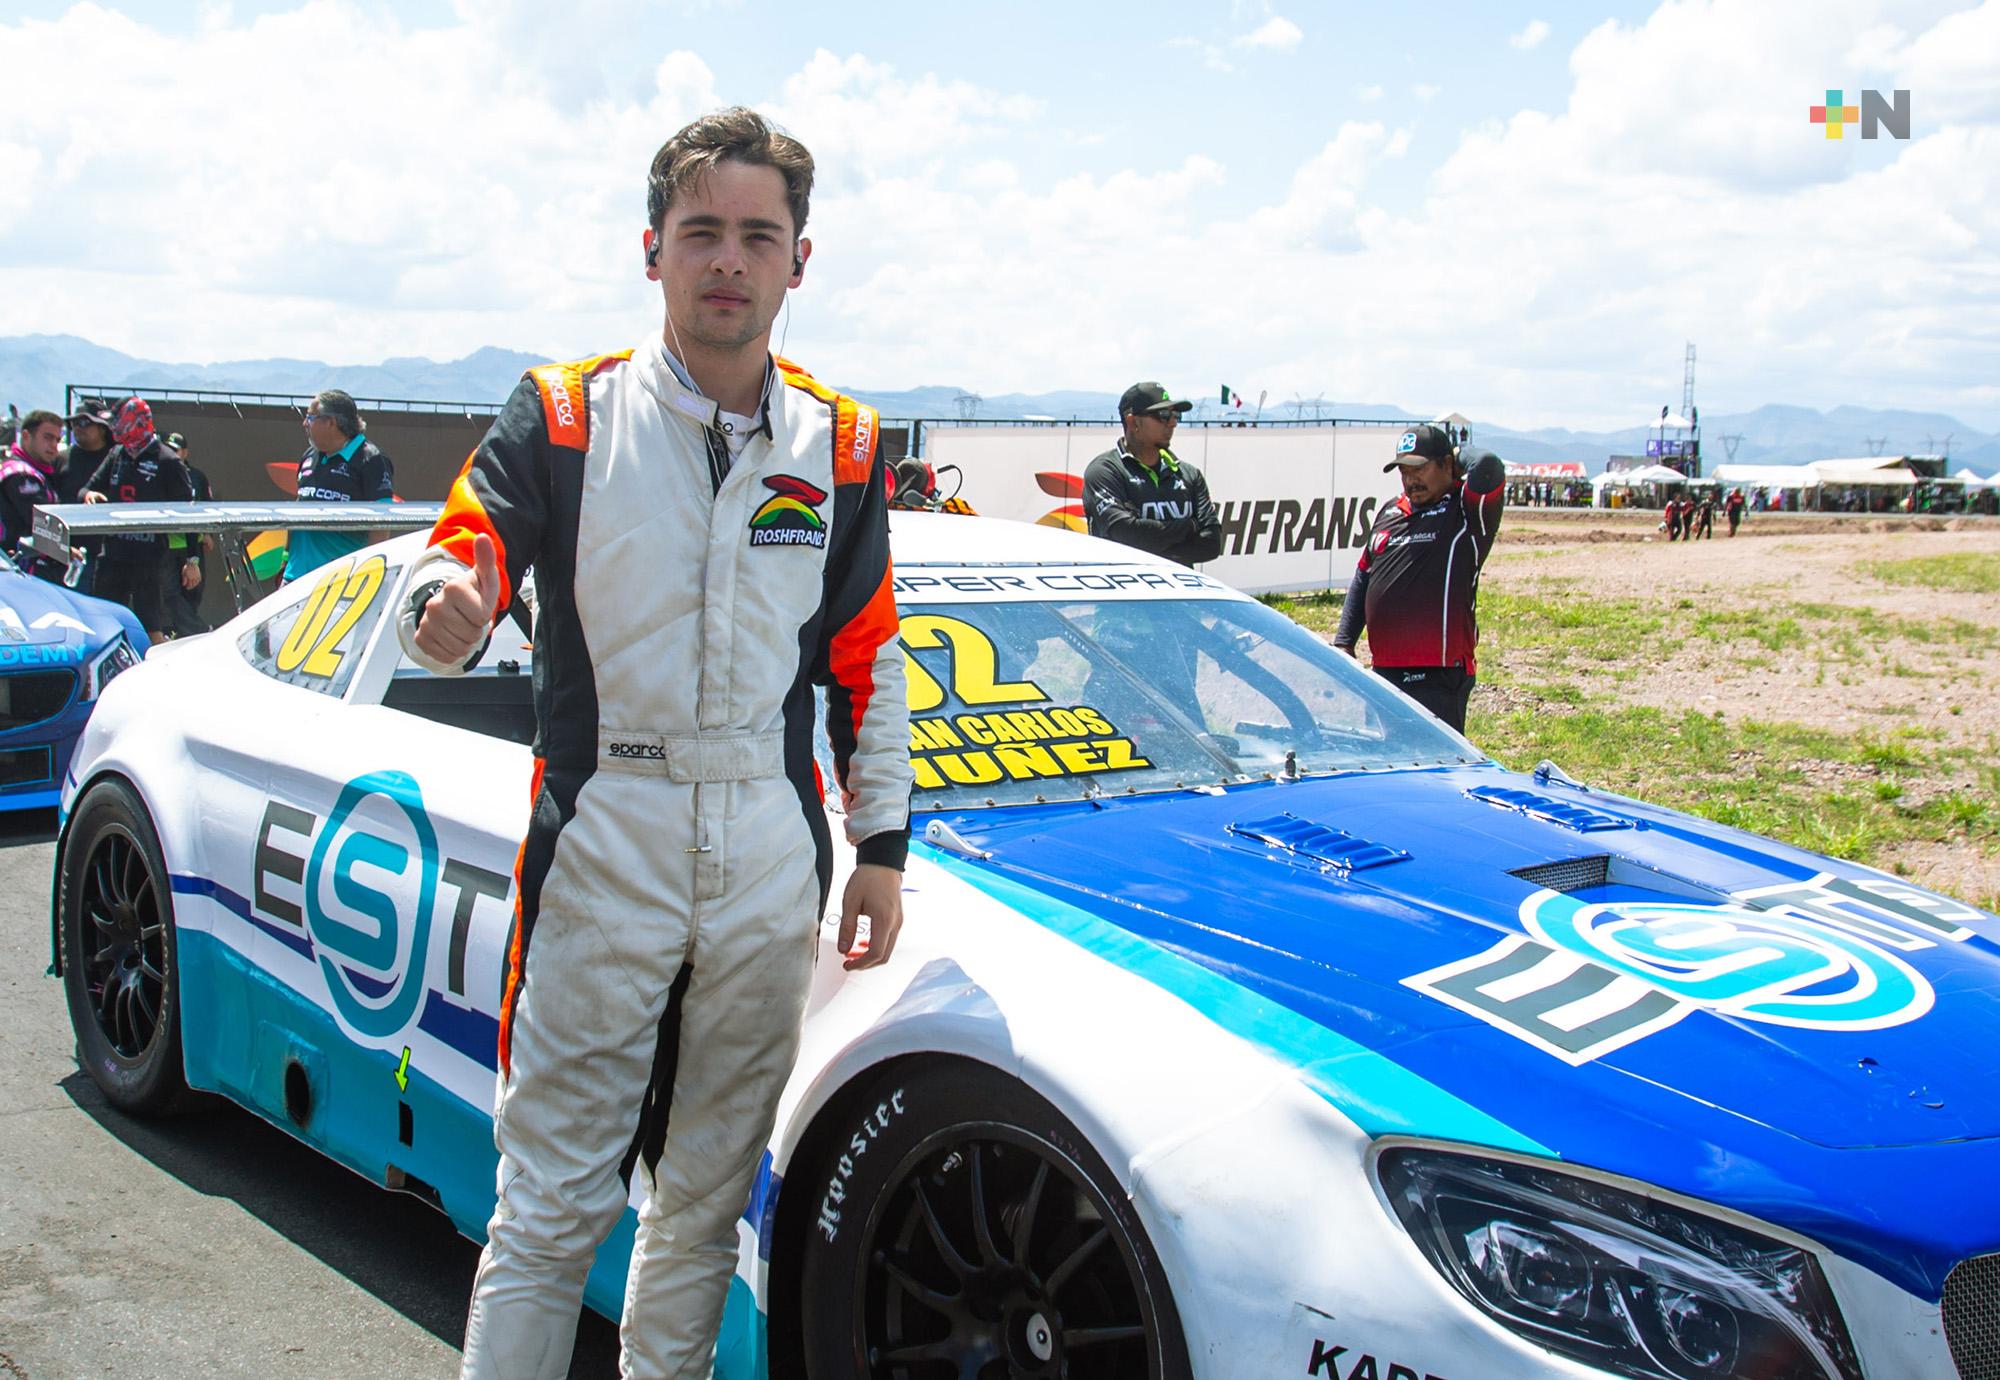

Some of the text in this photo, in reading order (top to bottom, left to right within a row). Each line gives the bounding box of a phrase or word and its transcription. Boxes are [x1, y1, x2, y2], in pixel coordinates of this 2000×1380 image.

[753, 528, 824, 546] ROSHFRANS
[276, 554, 387, 679] 02
[1036, 573, 1175, 590] COPA
[955, 706, 1115, 746] CARLOS
[254, 785, 513, 1015] EST
[817, 1088, 905, 1244] Hoosier
